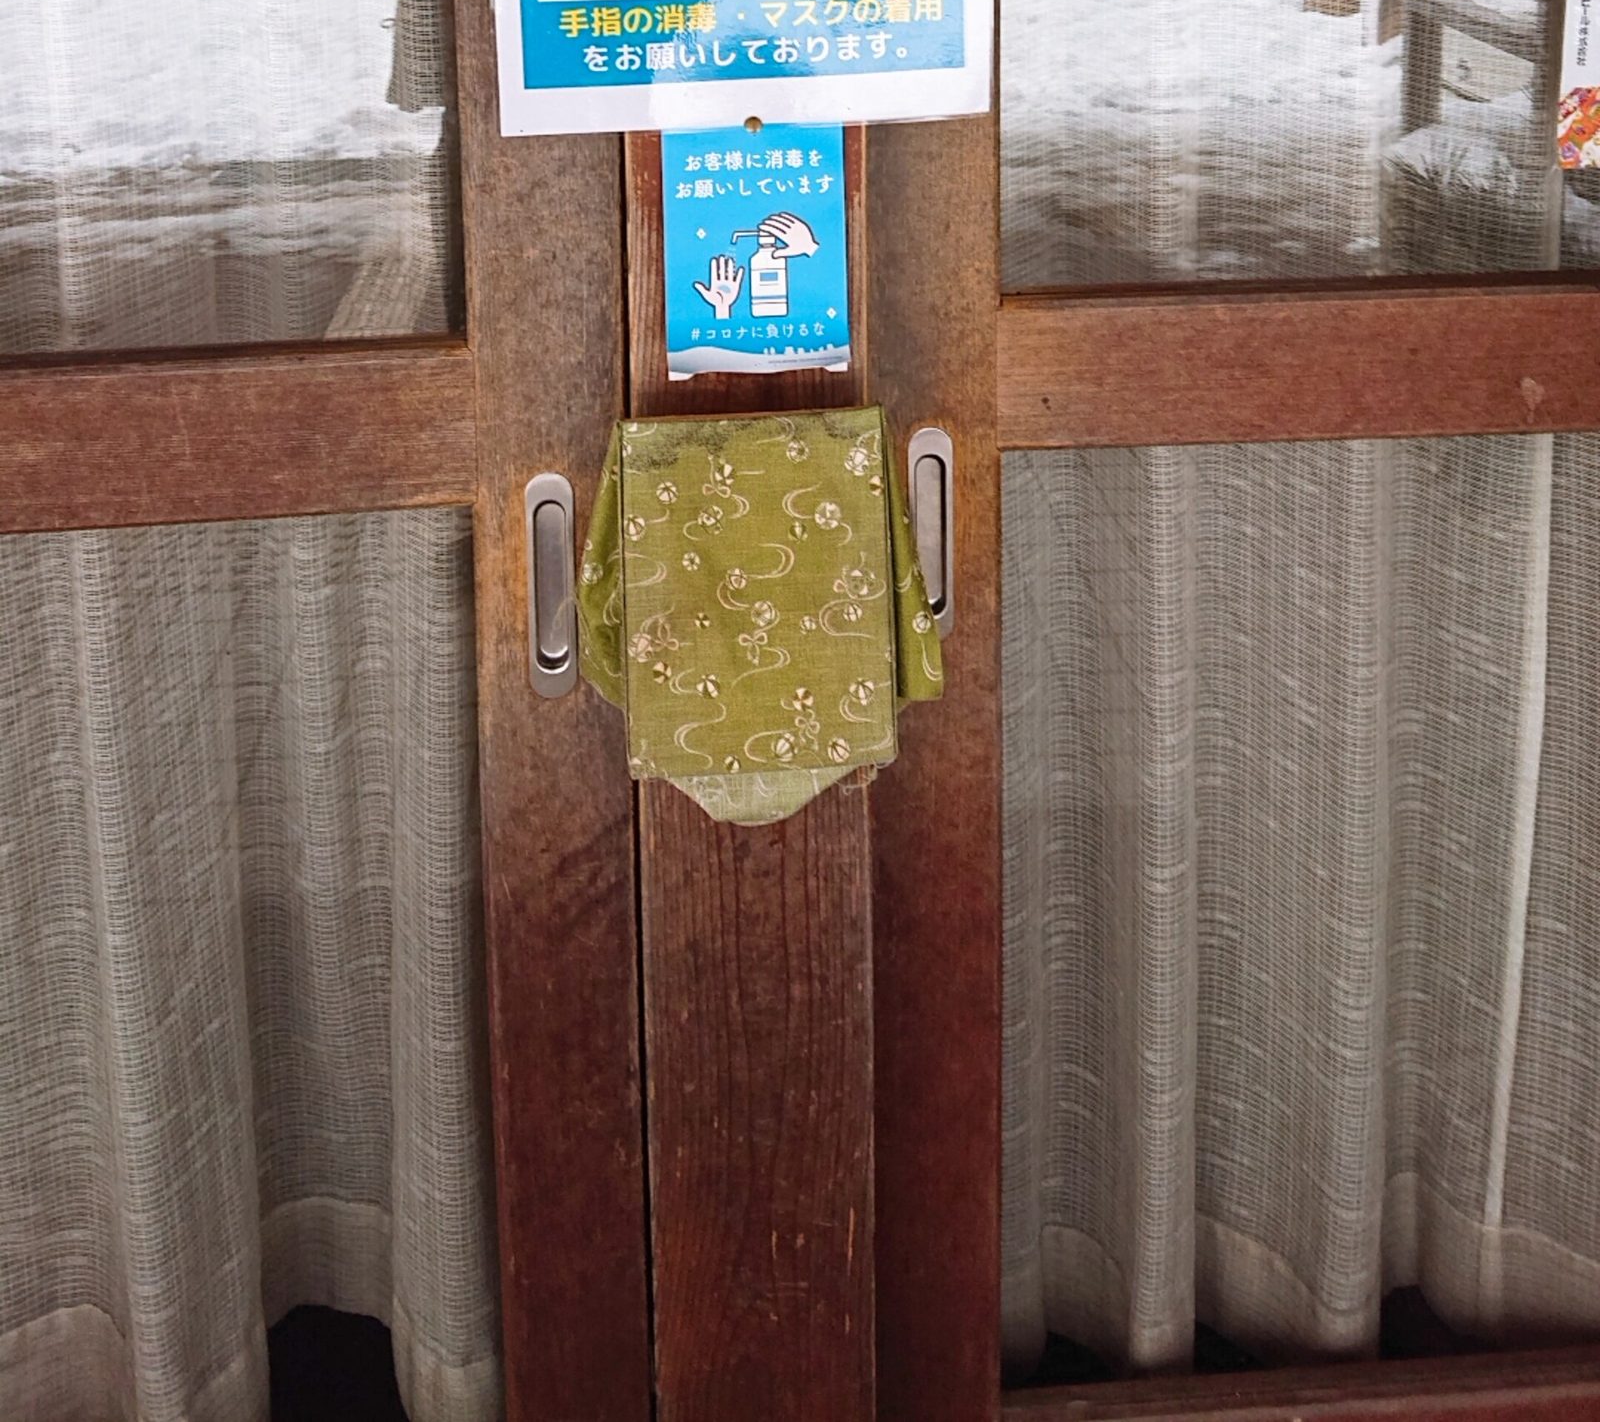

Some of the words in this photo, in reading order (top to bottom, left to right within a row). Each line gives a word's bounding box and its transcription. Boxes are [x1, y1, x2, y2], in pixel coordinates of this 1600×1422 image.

[582, 31, 908, 72] をお願いしております。
[684, 148, 823, 172] お客様に消毒を
[675, 174, 835, 199] お願いしています
[690, 321, 826, 342] #コロナに負けるな
